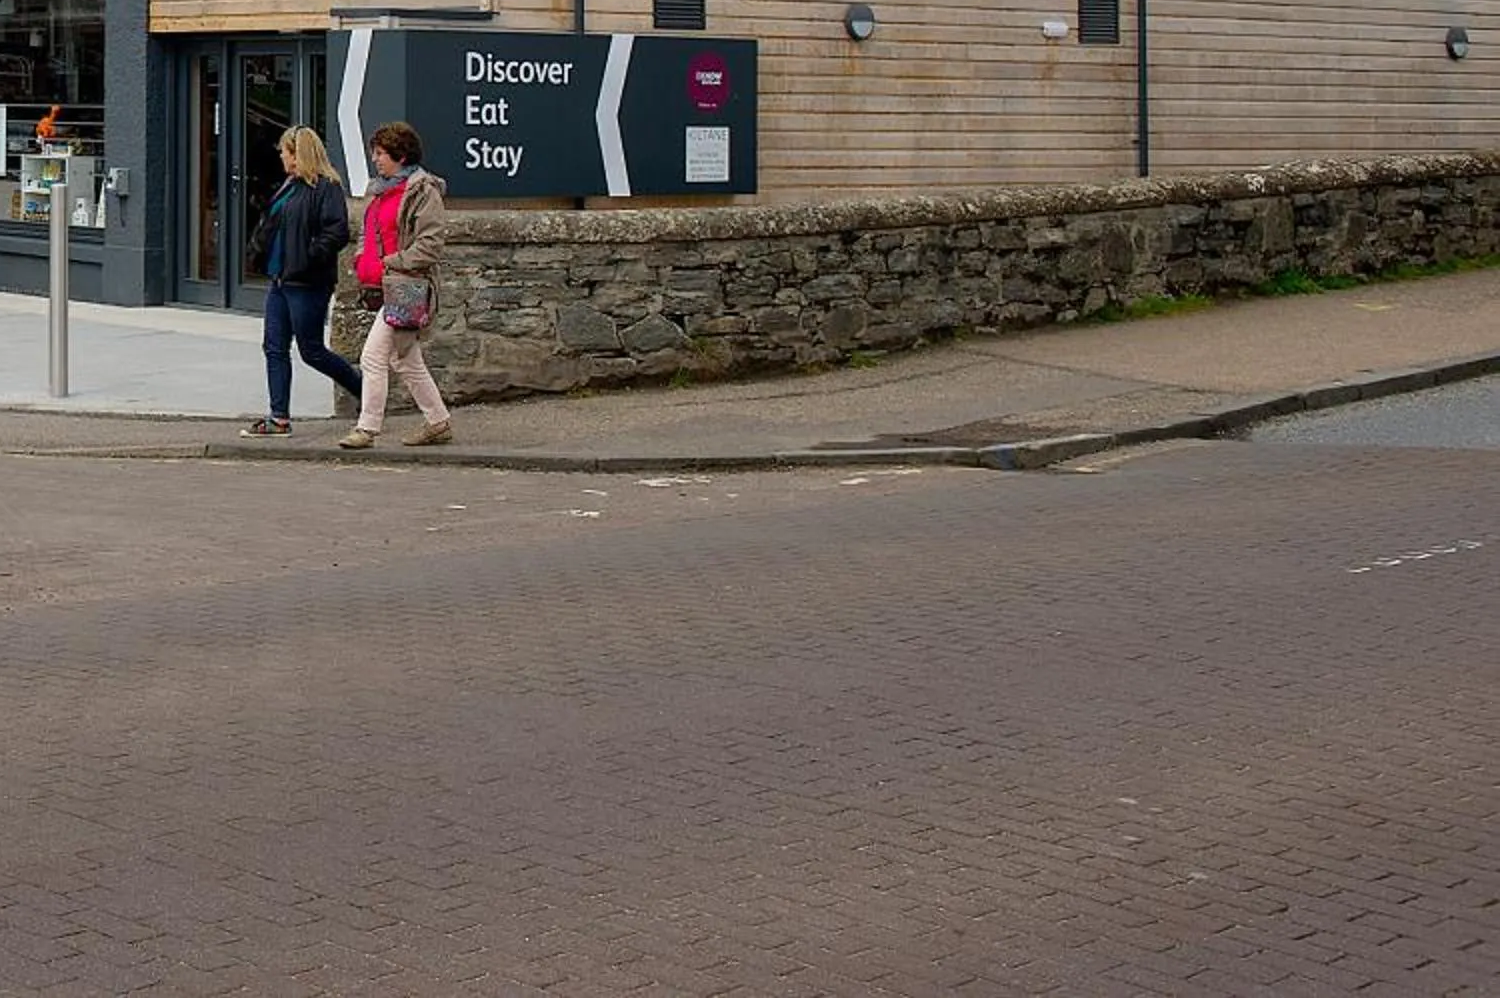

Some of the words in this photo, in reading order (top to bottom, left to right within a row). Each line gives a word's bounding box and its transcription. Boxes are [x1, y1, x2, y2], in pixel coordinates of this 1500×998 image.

[465, 51, 573, 84] Discover
[465, 95, 509, 125] Eat
[465, 137, 523, 177] Stay
